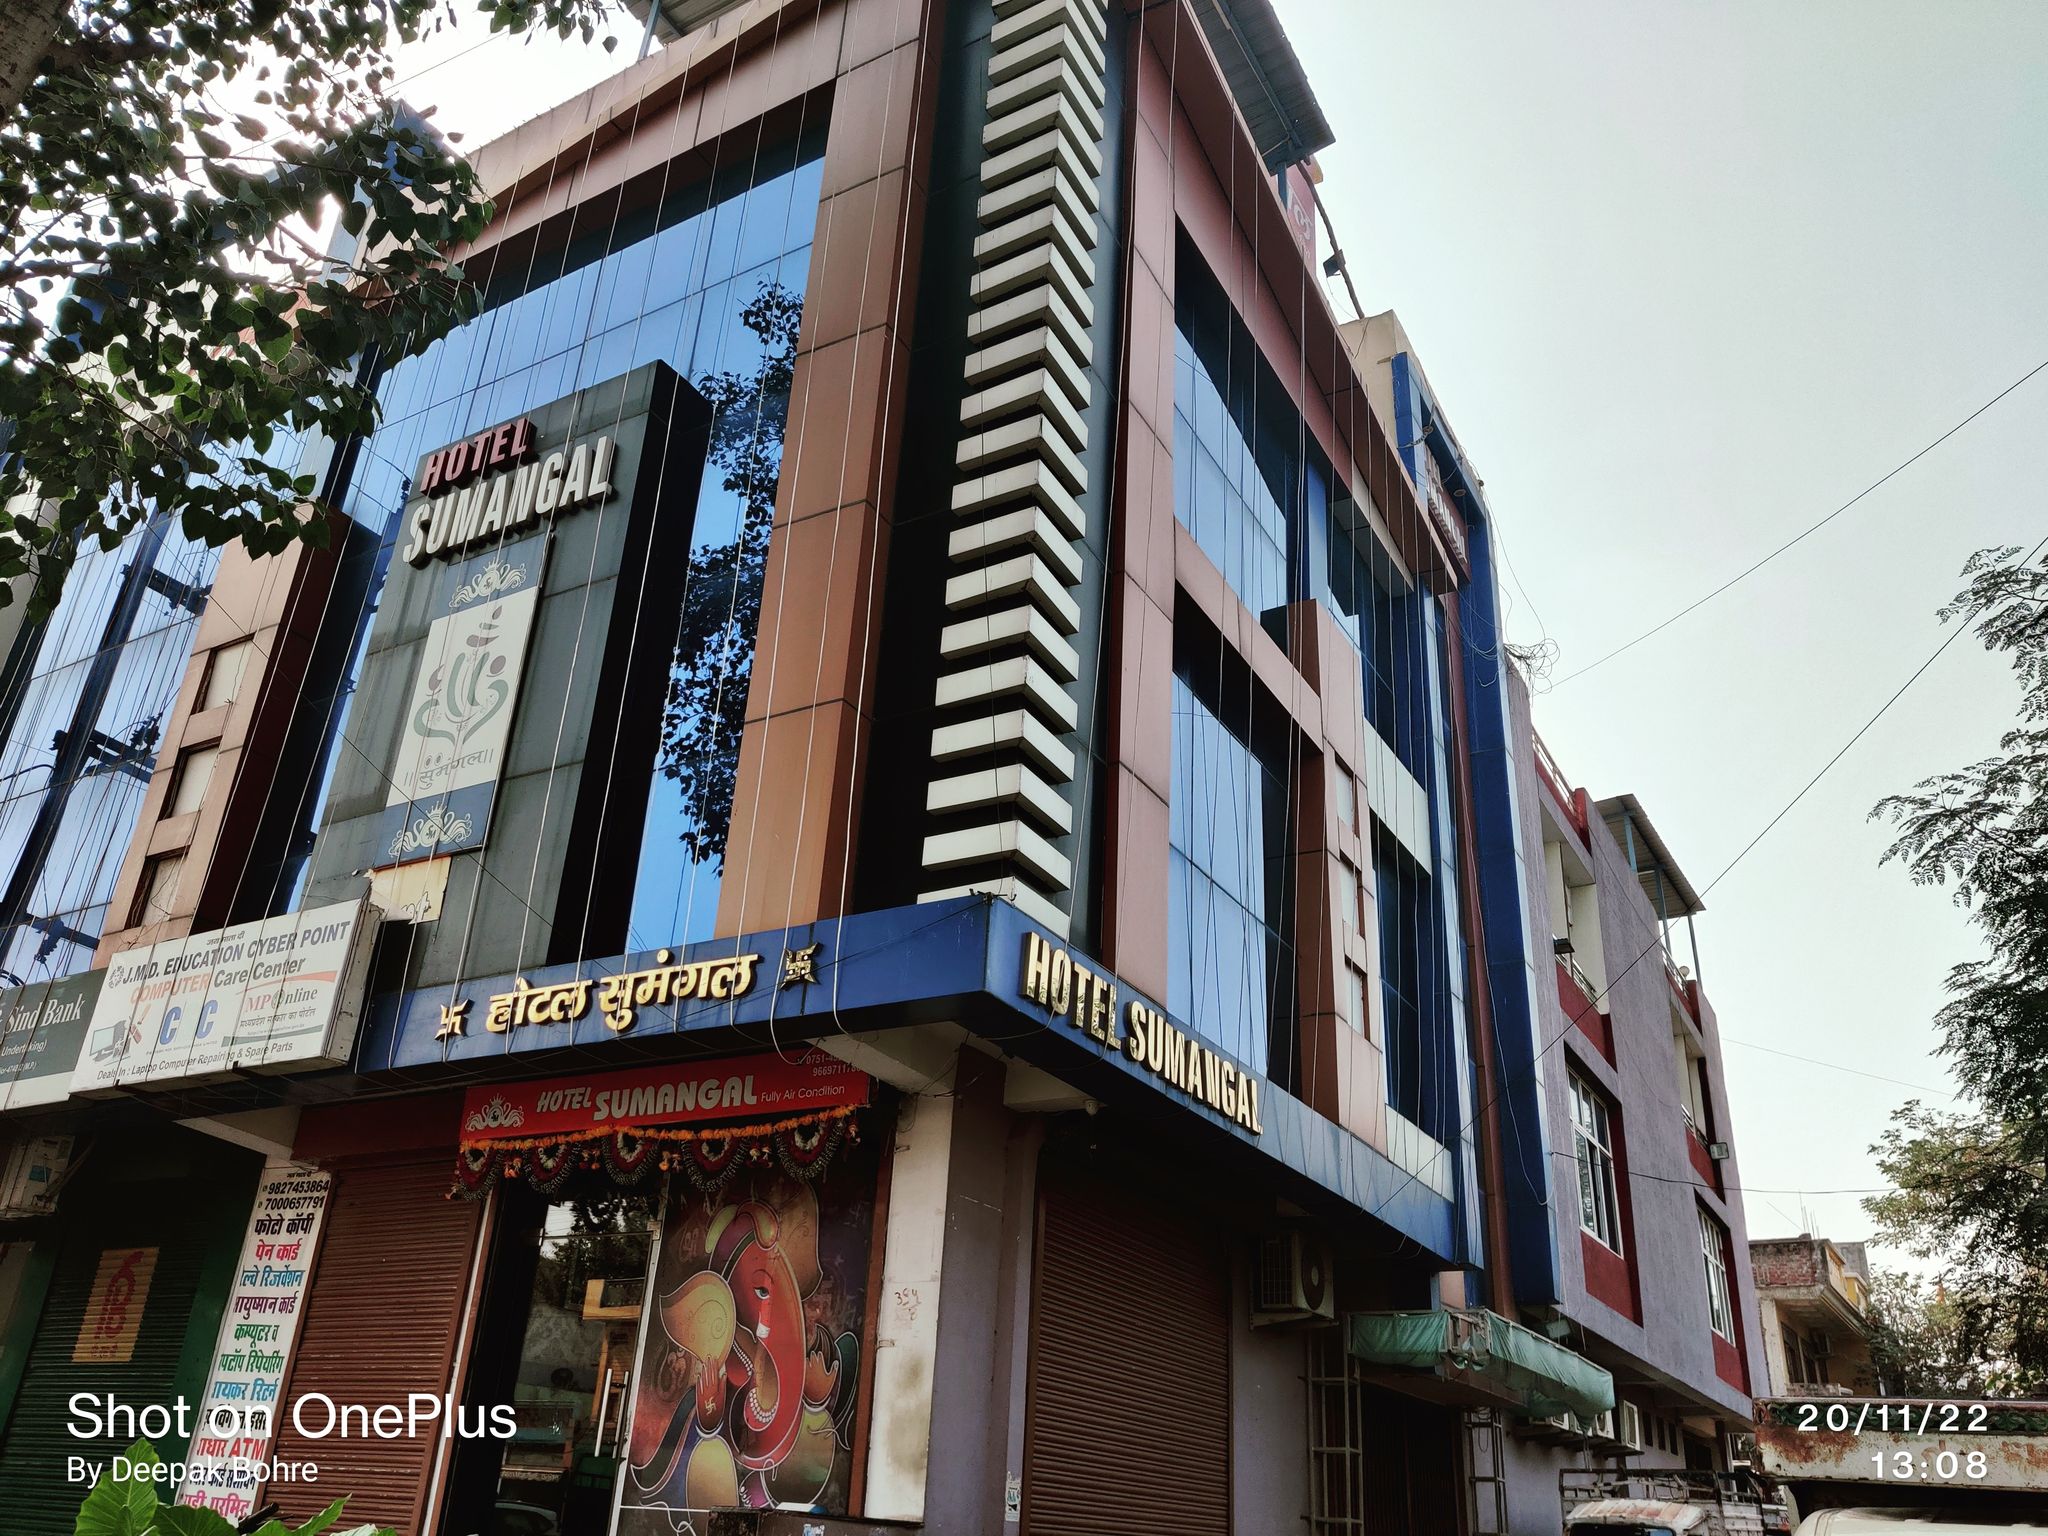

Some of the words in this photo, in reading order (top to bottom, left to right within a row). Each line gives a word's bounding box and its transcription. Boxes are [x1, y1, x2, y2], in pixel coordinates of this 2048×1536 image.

[420, 418, 533, 494] HOTEL
[403, 436, 615, 567] SUMANGAL
[163, 942, 245, 976] EDUCATION
[247, 932, 298, 959] CYBER
[300, 920, 351, 948] POINT
[130, 971, 211, 1005] COMPUTER
[214, 966, 249, 988] Care
[252, 957, 307, 981] Center
[486, 976, 598, 1033] होटल
[597, 948, 762, 1033] सुमंगल
[5, 1001, 43, 1034] Sind
[40, 992, 86, 1028] Bank
[1, 1039, 48, 1057] Undertking)
[270, 1041, 293, 1054] Parts
[1019, 931, 1121, 1051] HOTEL
[1125, 1000, 1264, 1136] SUMANGAL
[536, 1086, 593, 1113] HOTEL
[592, 1075, 758, 1121] SUMANGAL
[760, 1091, 782, 1103] Fully
[783, 1089, 796, 1100] Air
[797, 1085, 845, 1099] Condition
[264, 1195, 326, 1210] 7000657791
[268, 1180, 330, 1194] 9827453864
[254, 1213, 286, 1236] फोटो
[285, 1212, 315, 1235] कॉपी
[255, 1239, 276, 1261] पेन
[276, 1238, 303, 1261] कार्ड
[278, 1290, 300, 1314] कार्ड
[228, 1437, 267, 1461] ATM
